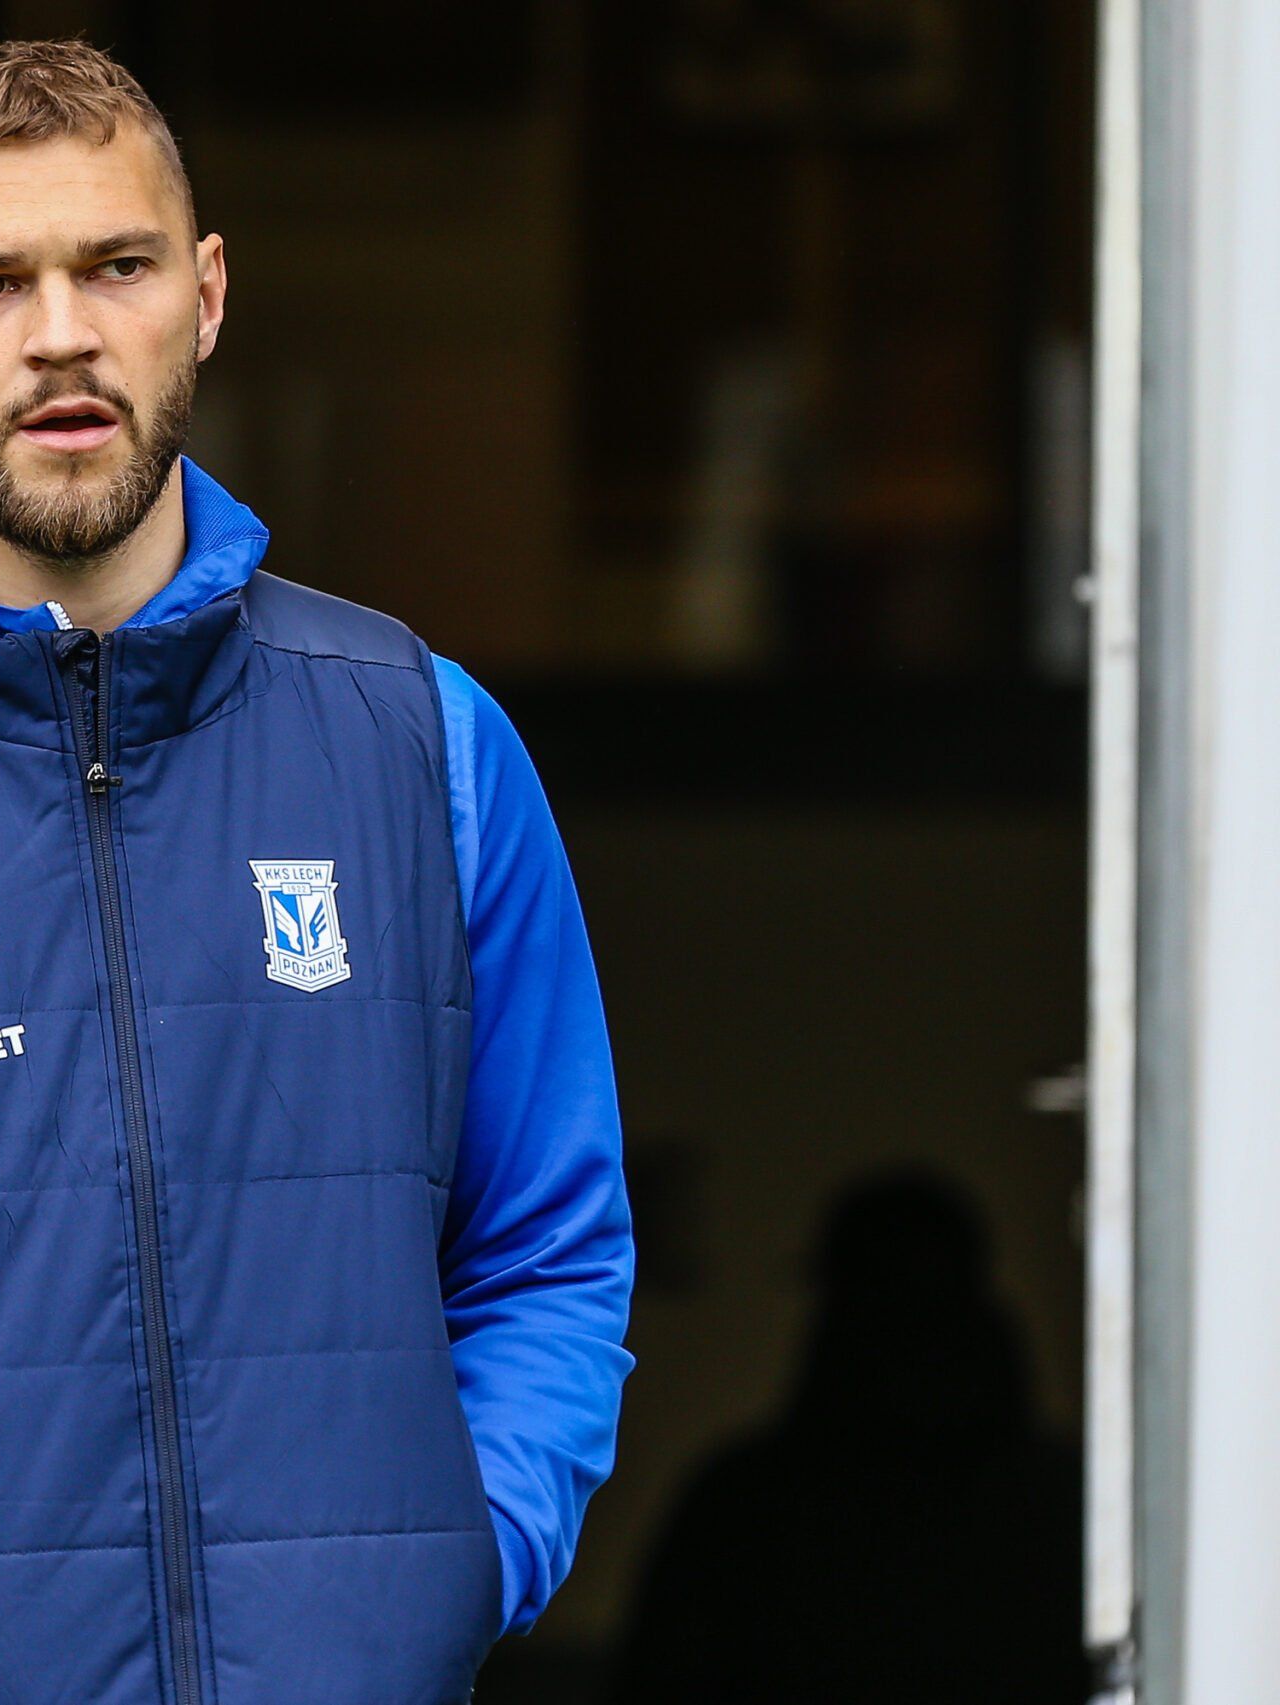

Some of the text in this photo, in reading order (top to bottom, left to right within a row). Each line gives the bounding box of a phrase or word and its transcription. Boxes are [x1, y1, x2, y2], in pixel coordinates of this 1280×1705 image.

[265, 868, 322, 880] KKS LECH
[287, 885, 307, 893] 1922
